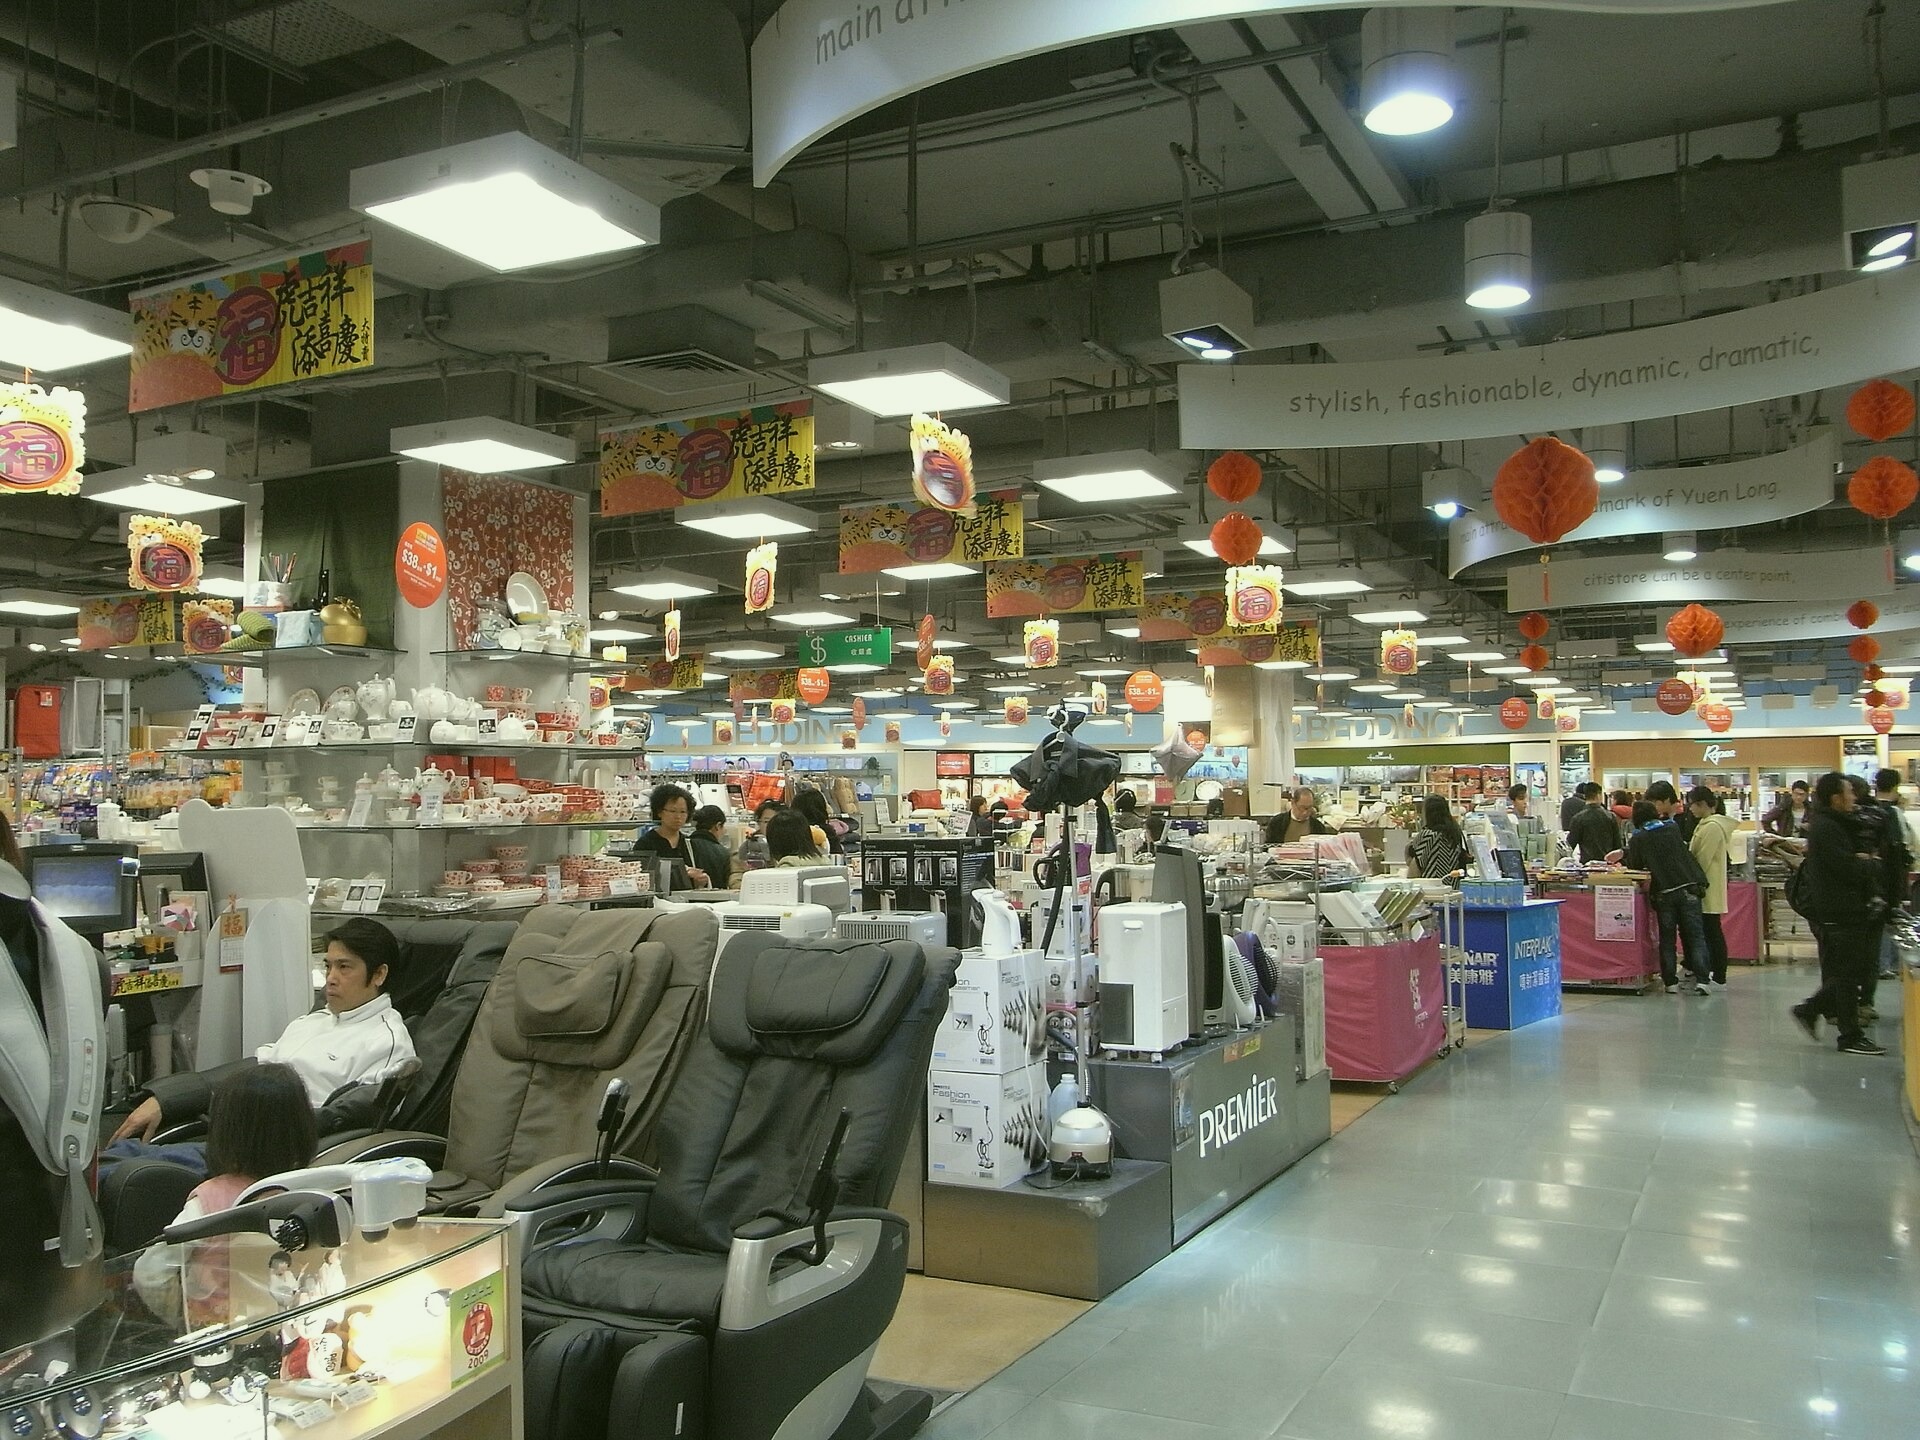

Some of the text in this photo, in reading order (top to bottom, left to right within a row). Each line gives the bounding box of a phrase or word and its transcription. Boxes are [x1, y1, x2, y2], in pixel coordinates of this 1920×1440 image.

[816, 4, 882, 65] main
[1289, 332, 1820, 419] stylish, fashionable, dynamic, dramatic,
[1653, 489, 1674, 507] of
[1681, 488, 1729, 505] Yuen
[1735, 481, 1781, 501] Long.
[1584, 572, 1647, 587] citistore
[1682, 568, 1700, 581] be
[1716, 568, 1754, 581] center
[1793, 613, 1806, 625] of
[844, 633, 873, 643] CASHIER
[932, 1088, 971, 1099] Fashion
[950, 1096, 981, 1105] Steamer
[467, 1349, 489, 1369] 2009
